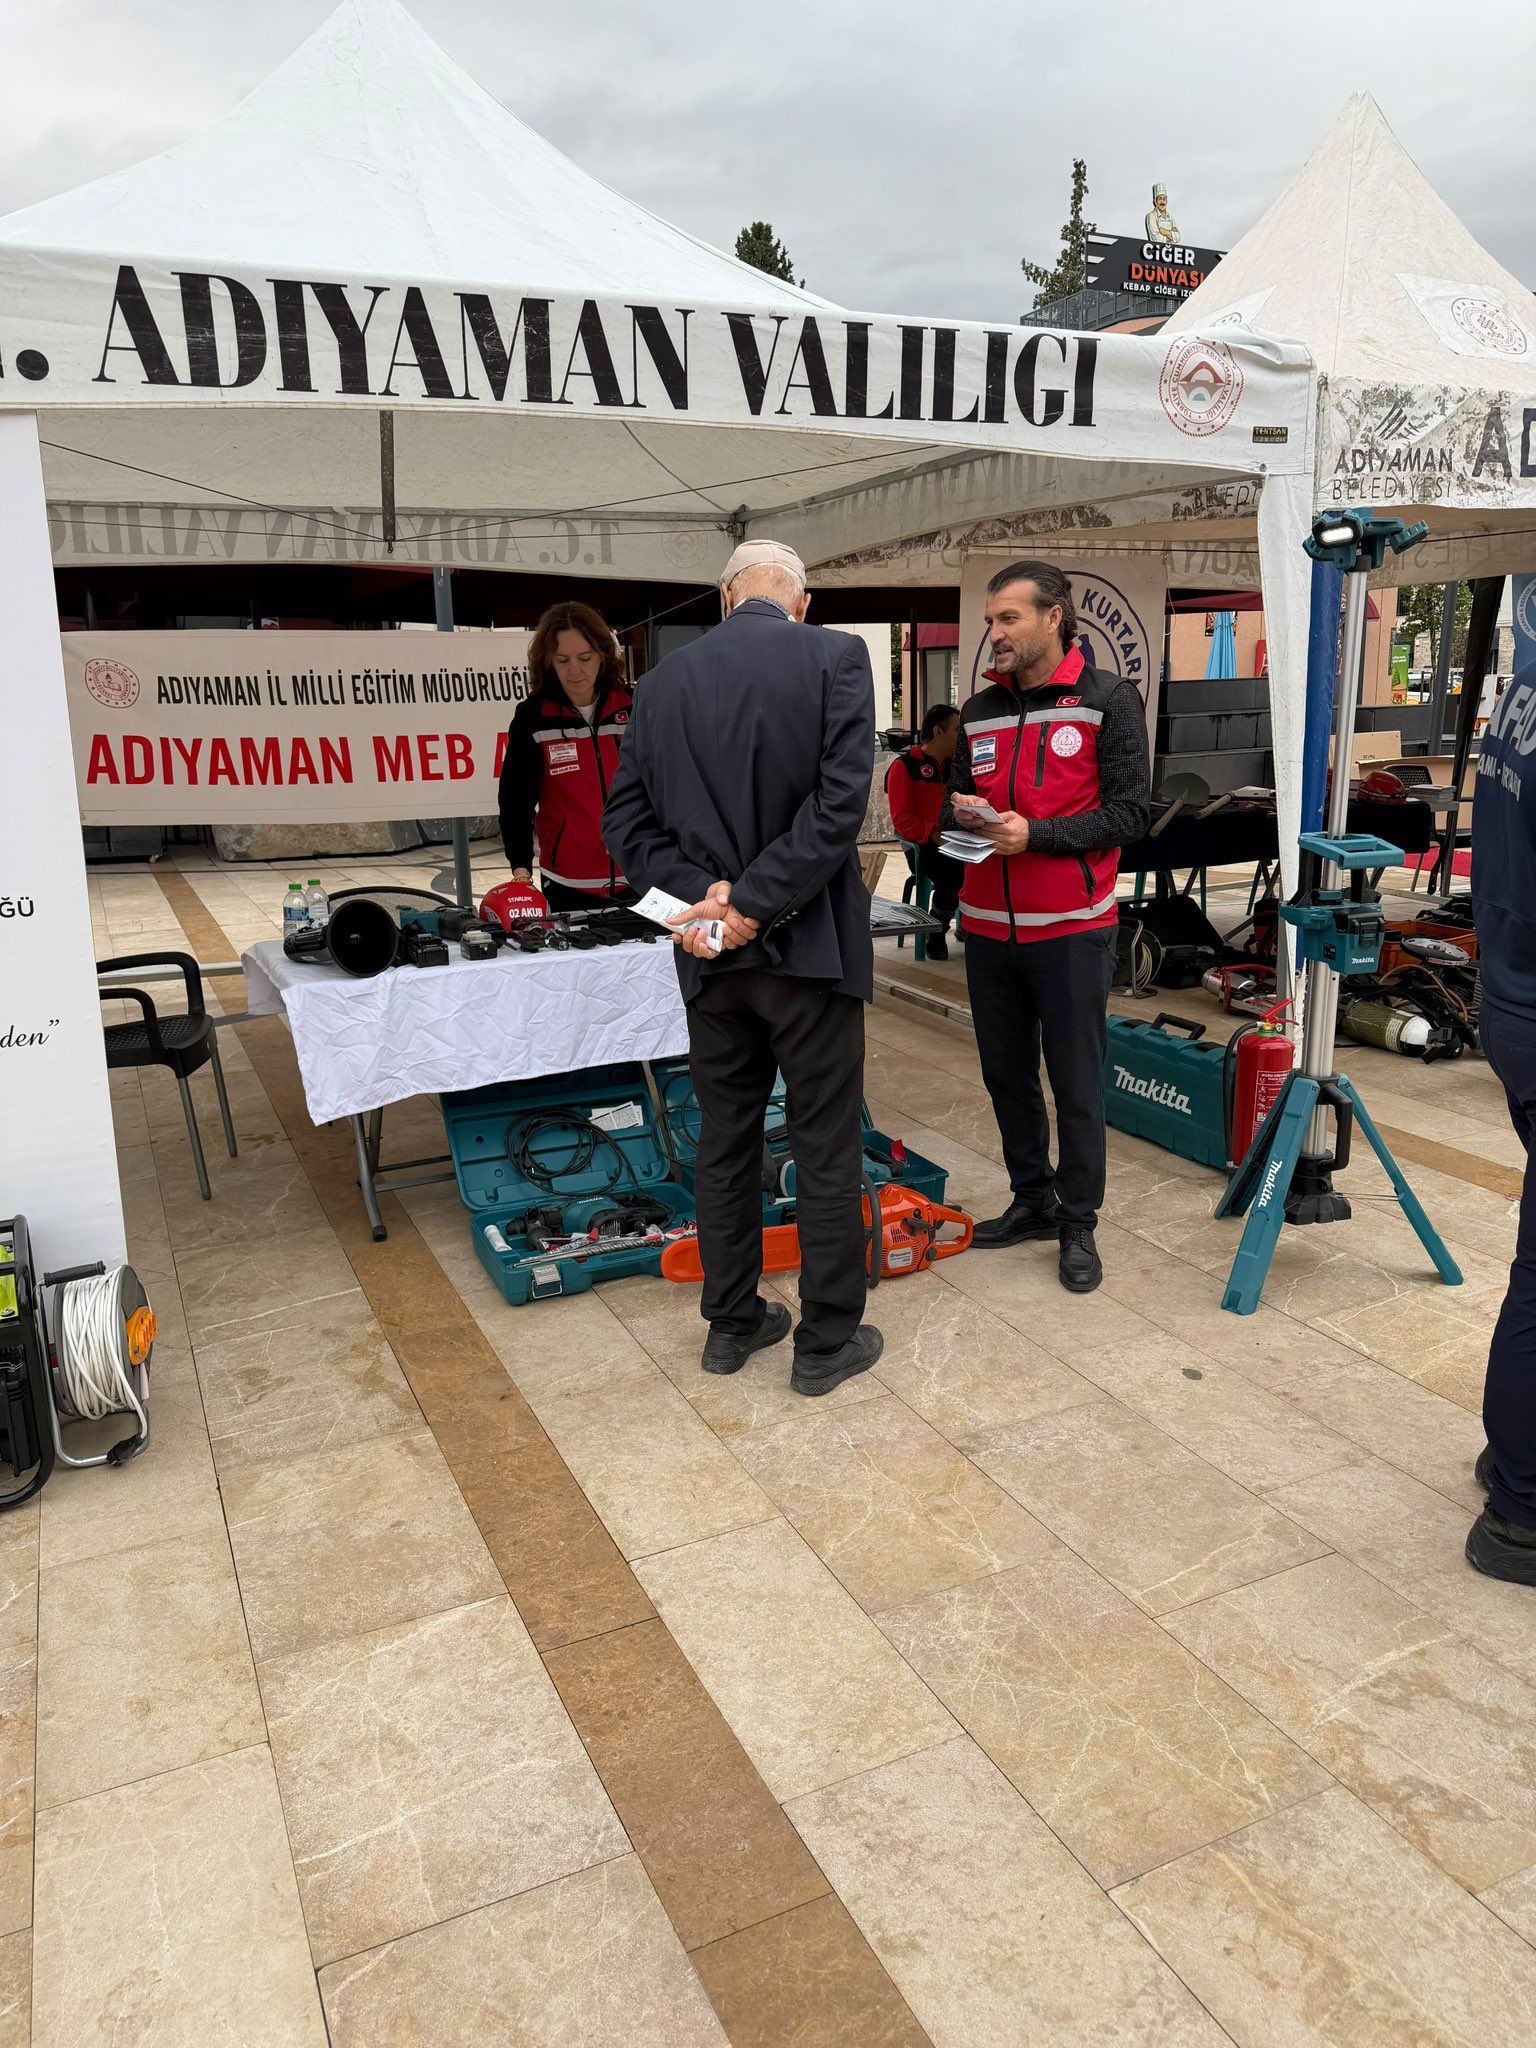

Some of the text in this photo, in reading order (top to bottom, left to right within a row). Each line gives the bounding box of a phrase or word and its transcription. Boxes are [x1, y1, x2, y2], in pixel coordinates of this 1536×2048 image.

[1143, 243, 1196, 266] CİĞER
[1123, 282, 1151, 293] KEBAP
[1154, 286, 1178, 296] CİĞER
[92, 265, 695, 410] ADIYAMAN
[1334, 447, 1453, 474] ADIYAMAN
[1332, 476, 1451, 500] BELEDİYESİ
[157, 675, 262, 706] ADIYAMAN
[270, 670, 288, 705] İL
[293, 670, 347, 705] MİLLİ
[352, 668, 416, 705] EĞİTİM
[86, 734, 353, 786] ADIYAMAN
[372, 732, 475, 784] MEB
[509, 908, 543, 918] 02 AKUB
